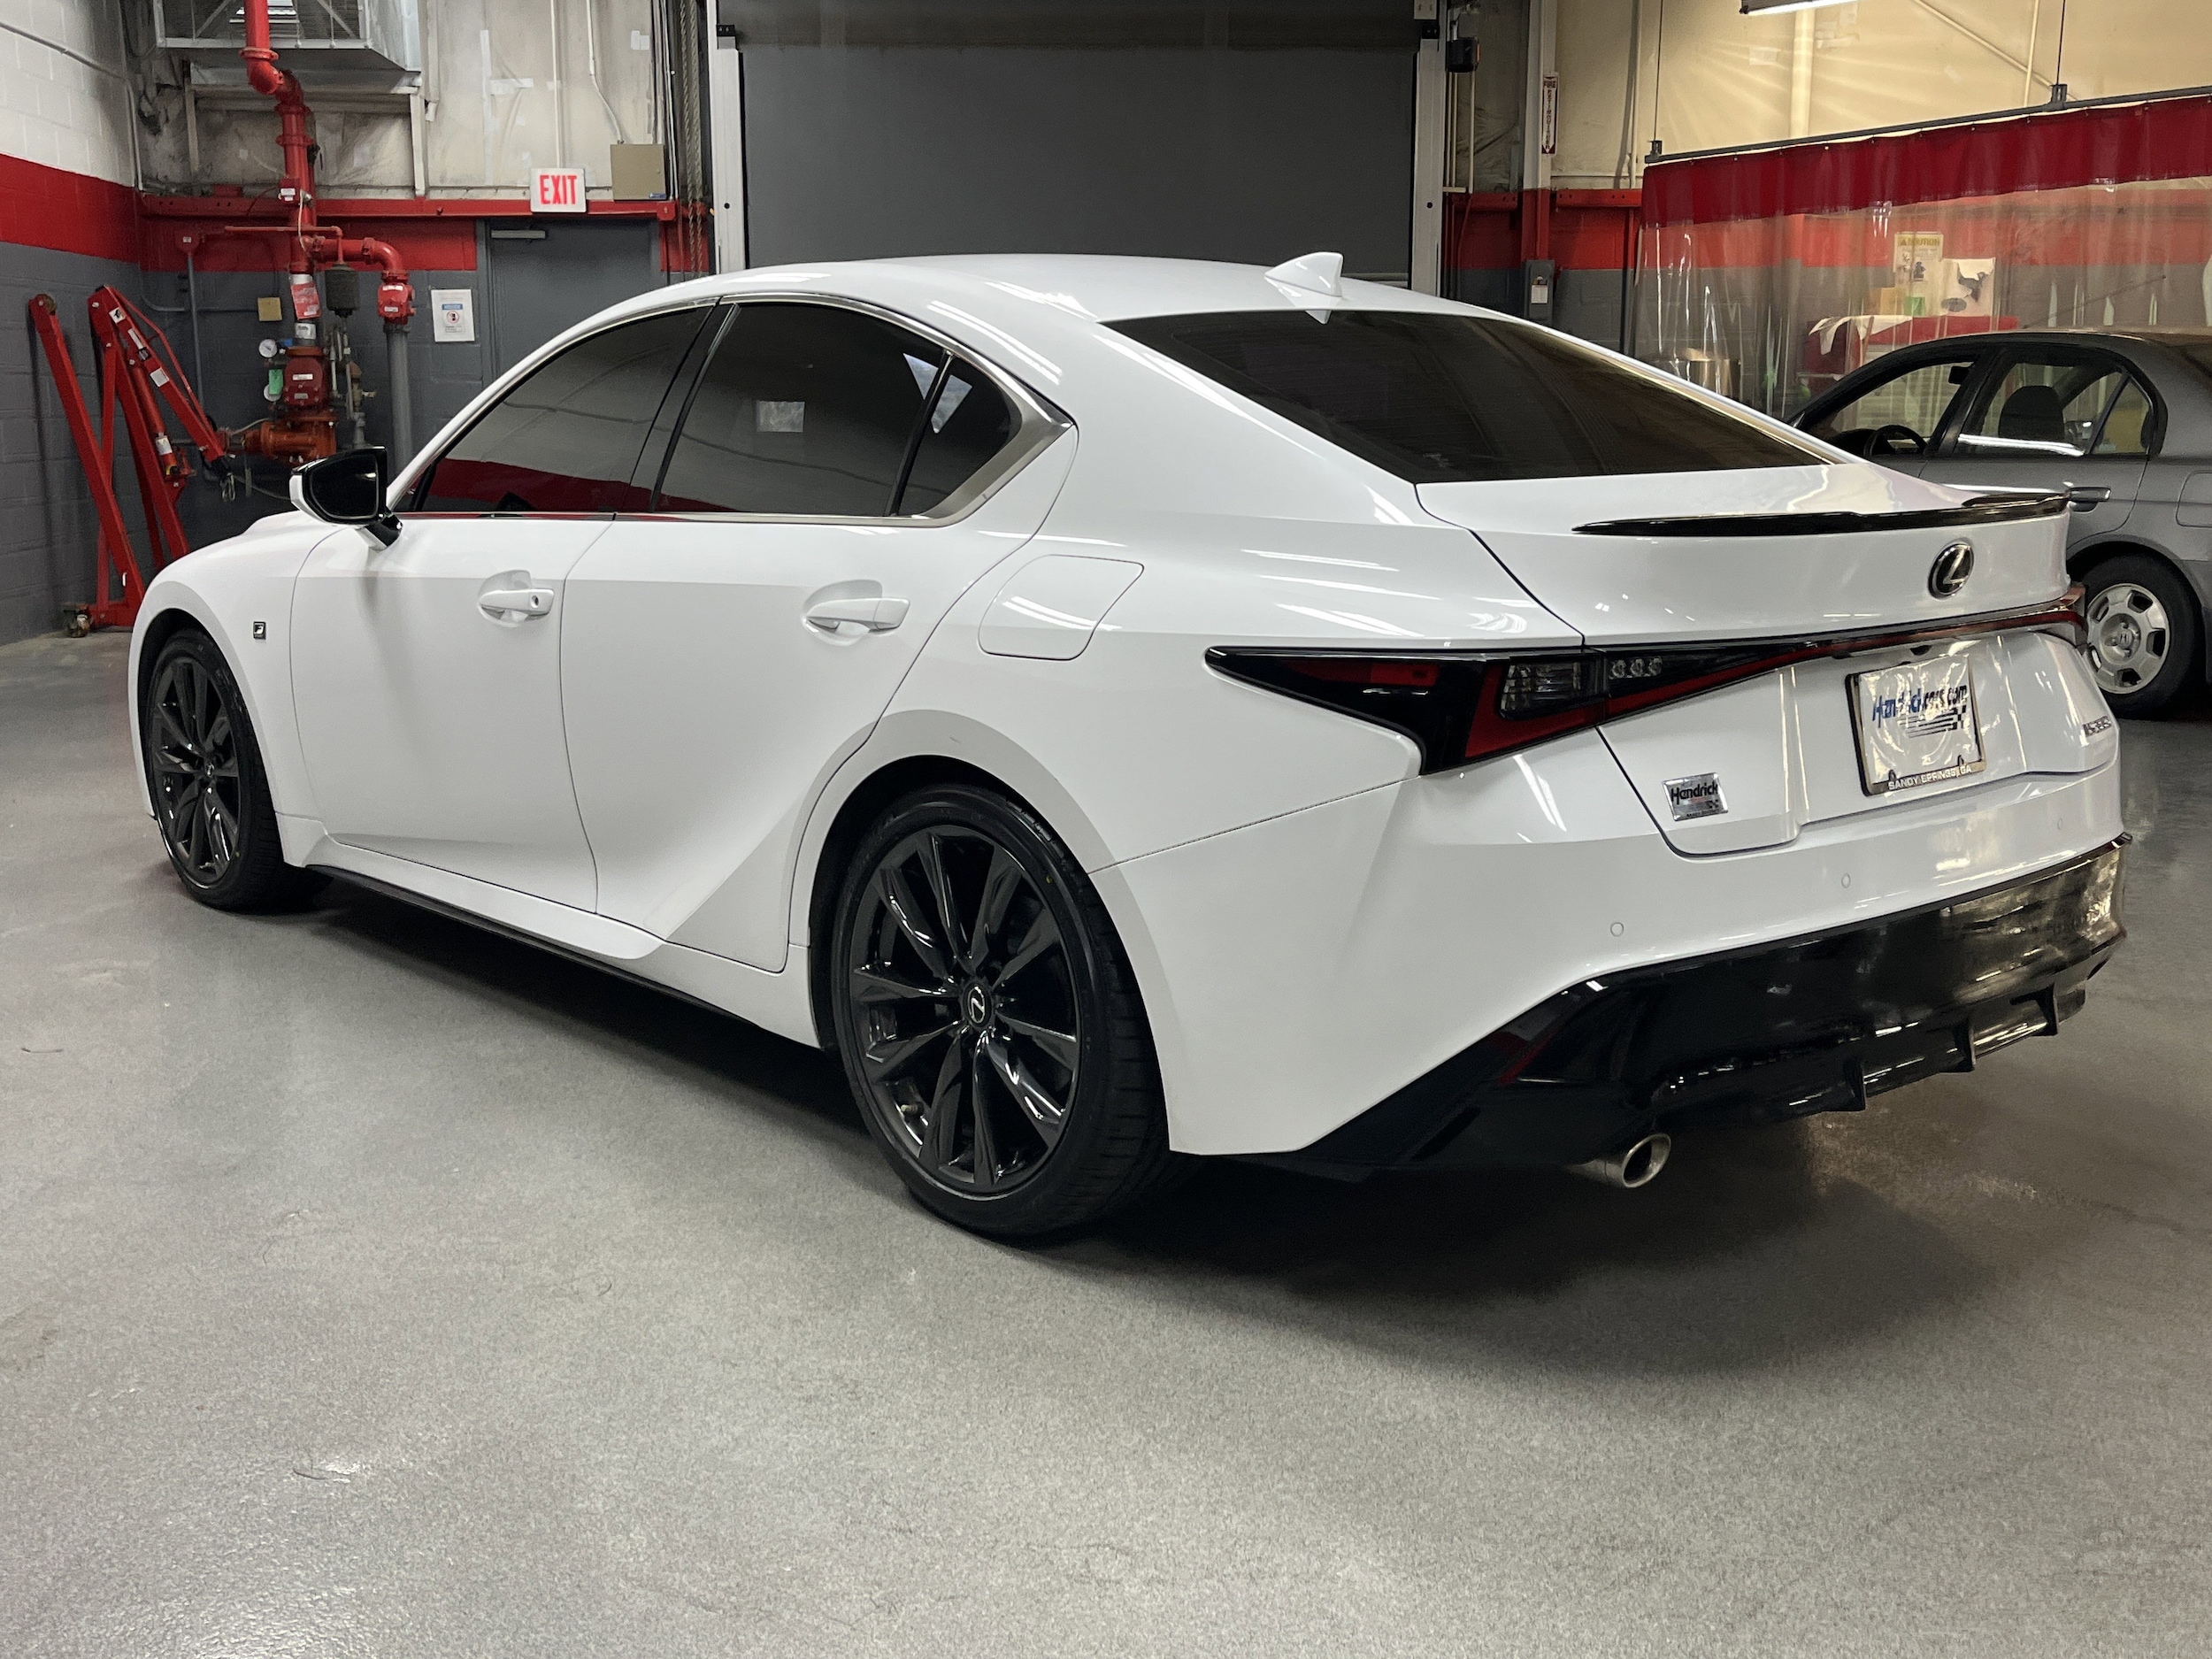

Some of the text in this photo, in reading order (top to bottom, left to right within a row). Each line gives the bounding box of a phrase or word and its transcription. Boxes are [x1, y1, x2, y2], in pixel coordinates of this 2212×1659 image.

[540, 174, 577, 204] EXIT
[1888, 776, 1919, 790] SANDY
[1960, 764, 1972, 774] GA
[1671, 780, 1718, 805] Hendrick
